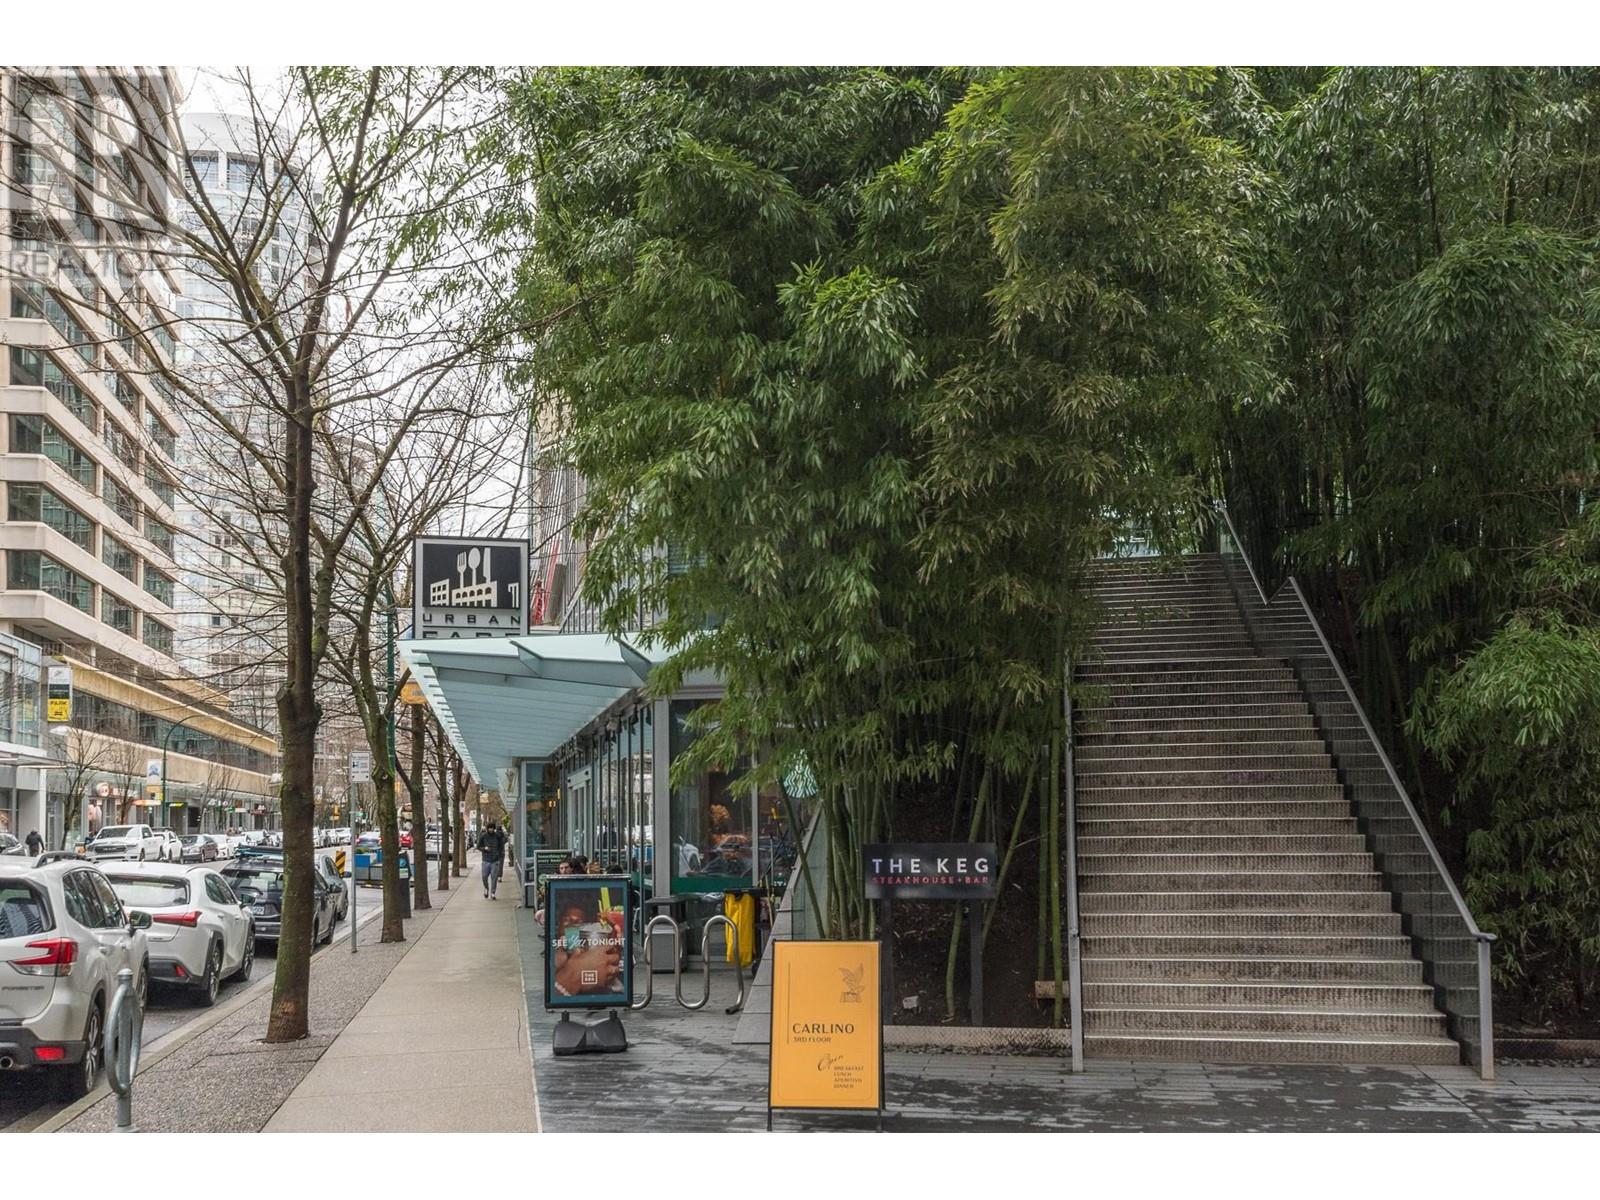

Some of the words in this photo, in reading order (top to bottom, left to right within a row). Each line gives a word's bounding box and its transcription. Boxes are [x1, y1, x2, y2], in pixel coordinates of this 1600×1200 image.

[422, 613, 521, 625] URBAN
[872, 858, 921, 873] THE
[936, 858, 989, 873] KEG
[872, 876, 954, 885] STEAKHOUSE
[964, 876, 989, 885] BAR
[552, 939, 568, 948] SEE
[588, 938, 626, 947] TONIGHT
[792, 1023, 855, 1035] CARLINO
